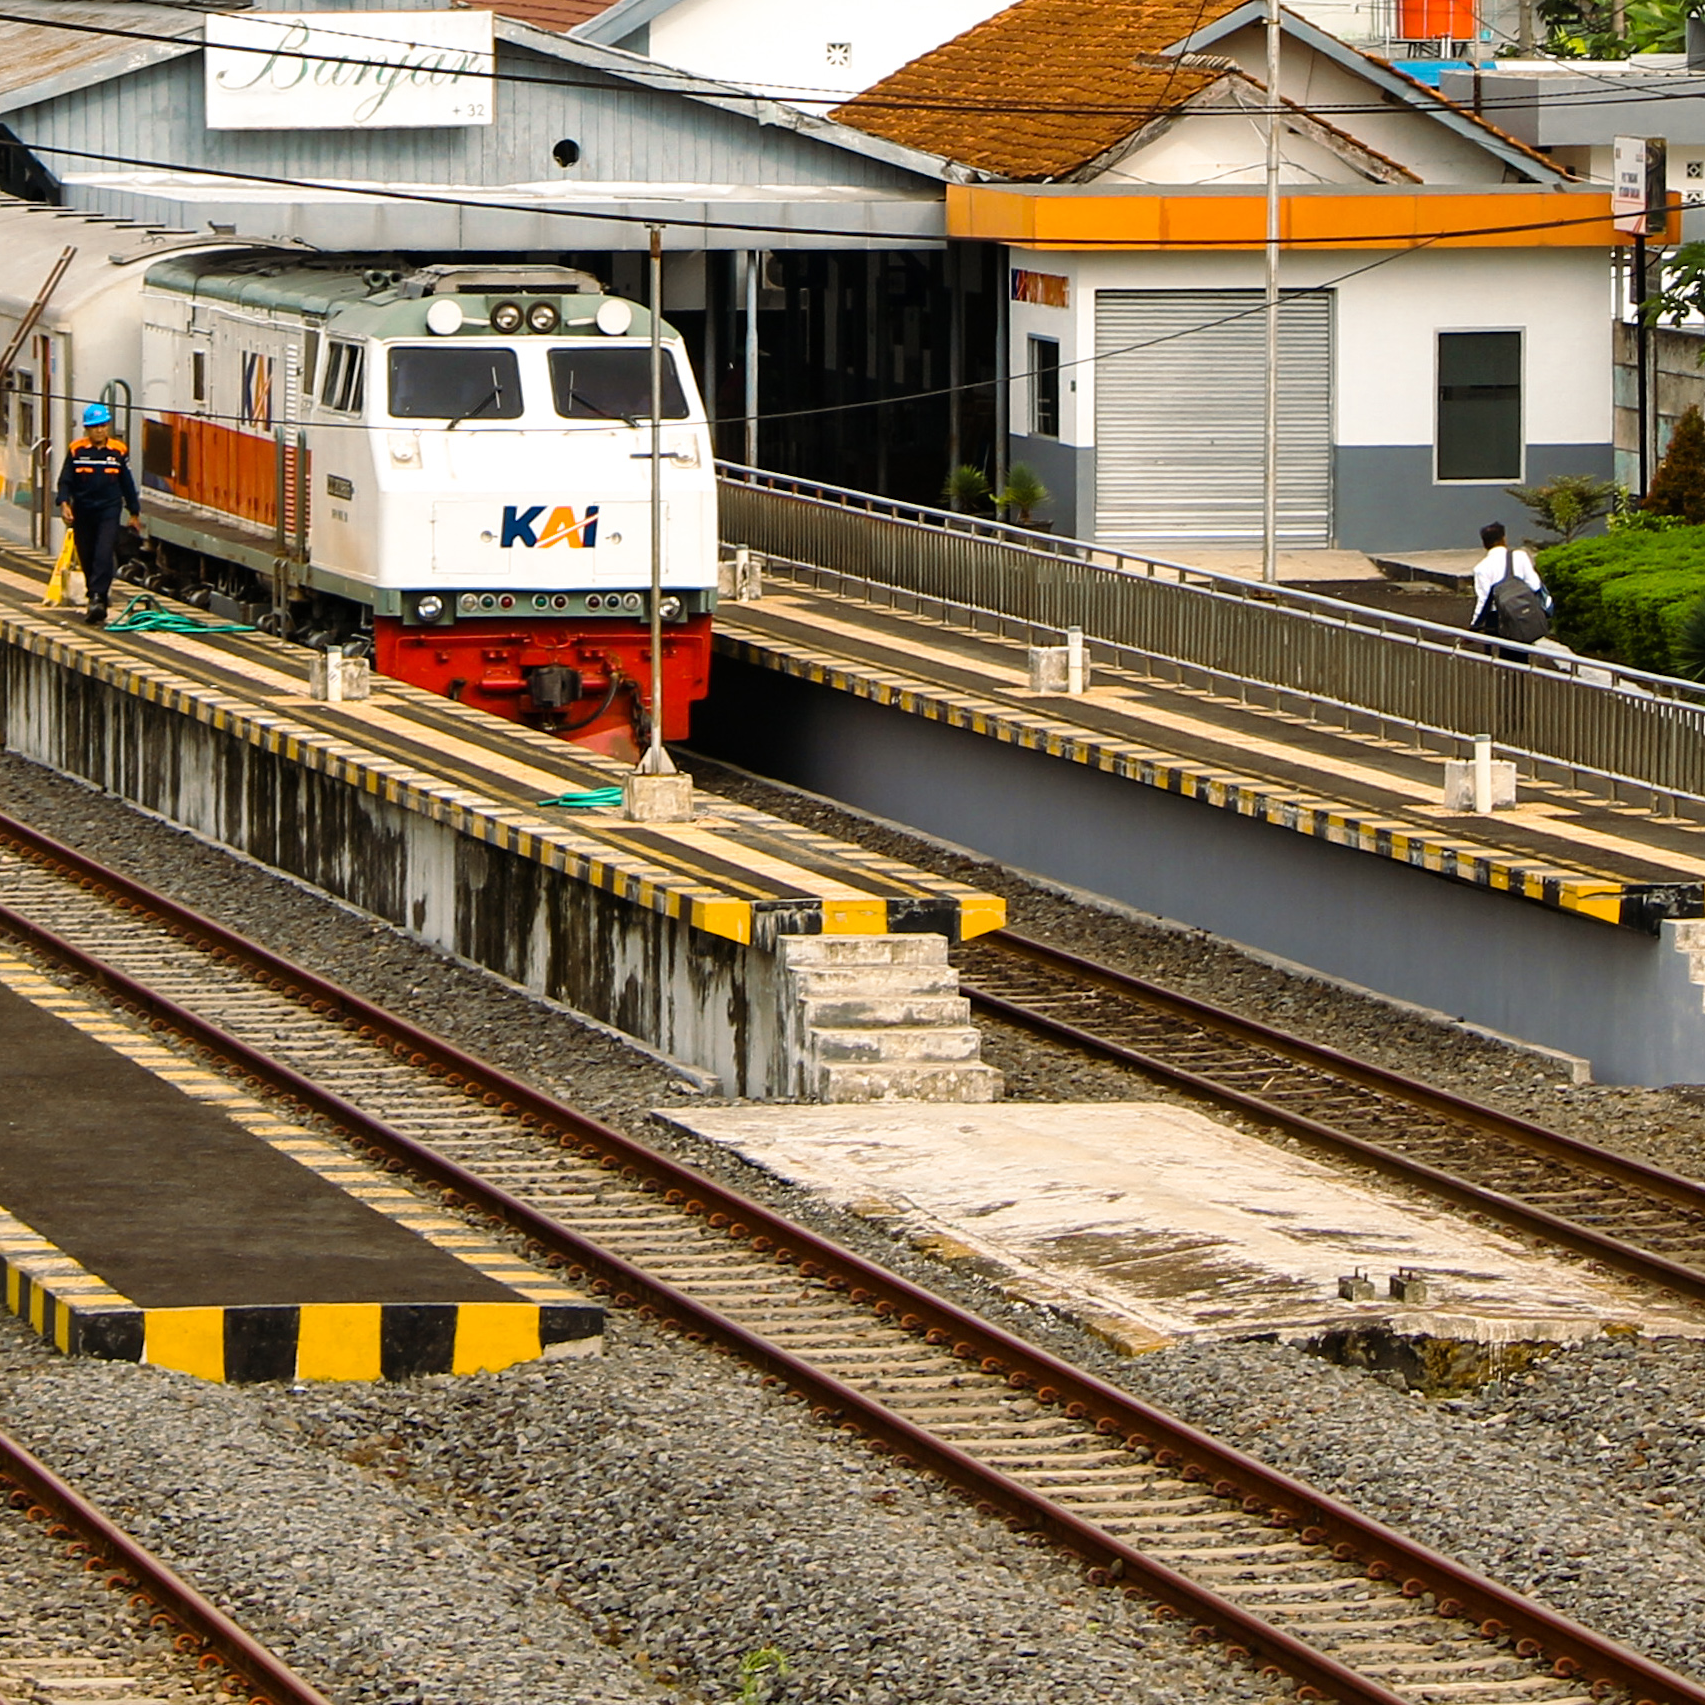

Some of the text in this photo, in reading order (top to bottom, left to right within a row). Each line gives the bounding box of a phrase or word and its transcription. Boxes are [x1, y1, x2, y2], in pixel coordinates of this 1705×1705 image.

[215, 18, 485, 123] Banjar
[467, 103, 485, 117] 32
[500, 505, 600, 549] KAI
